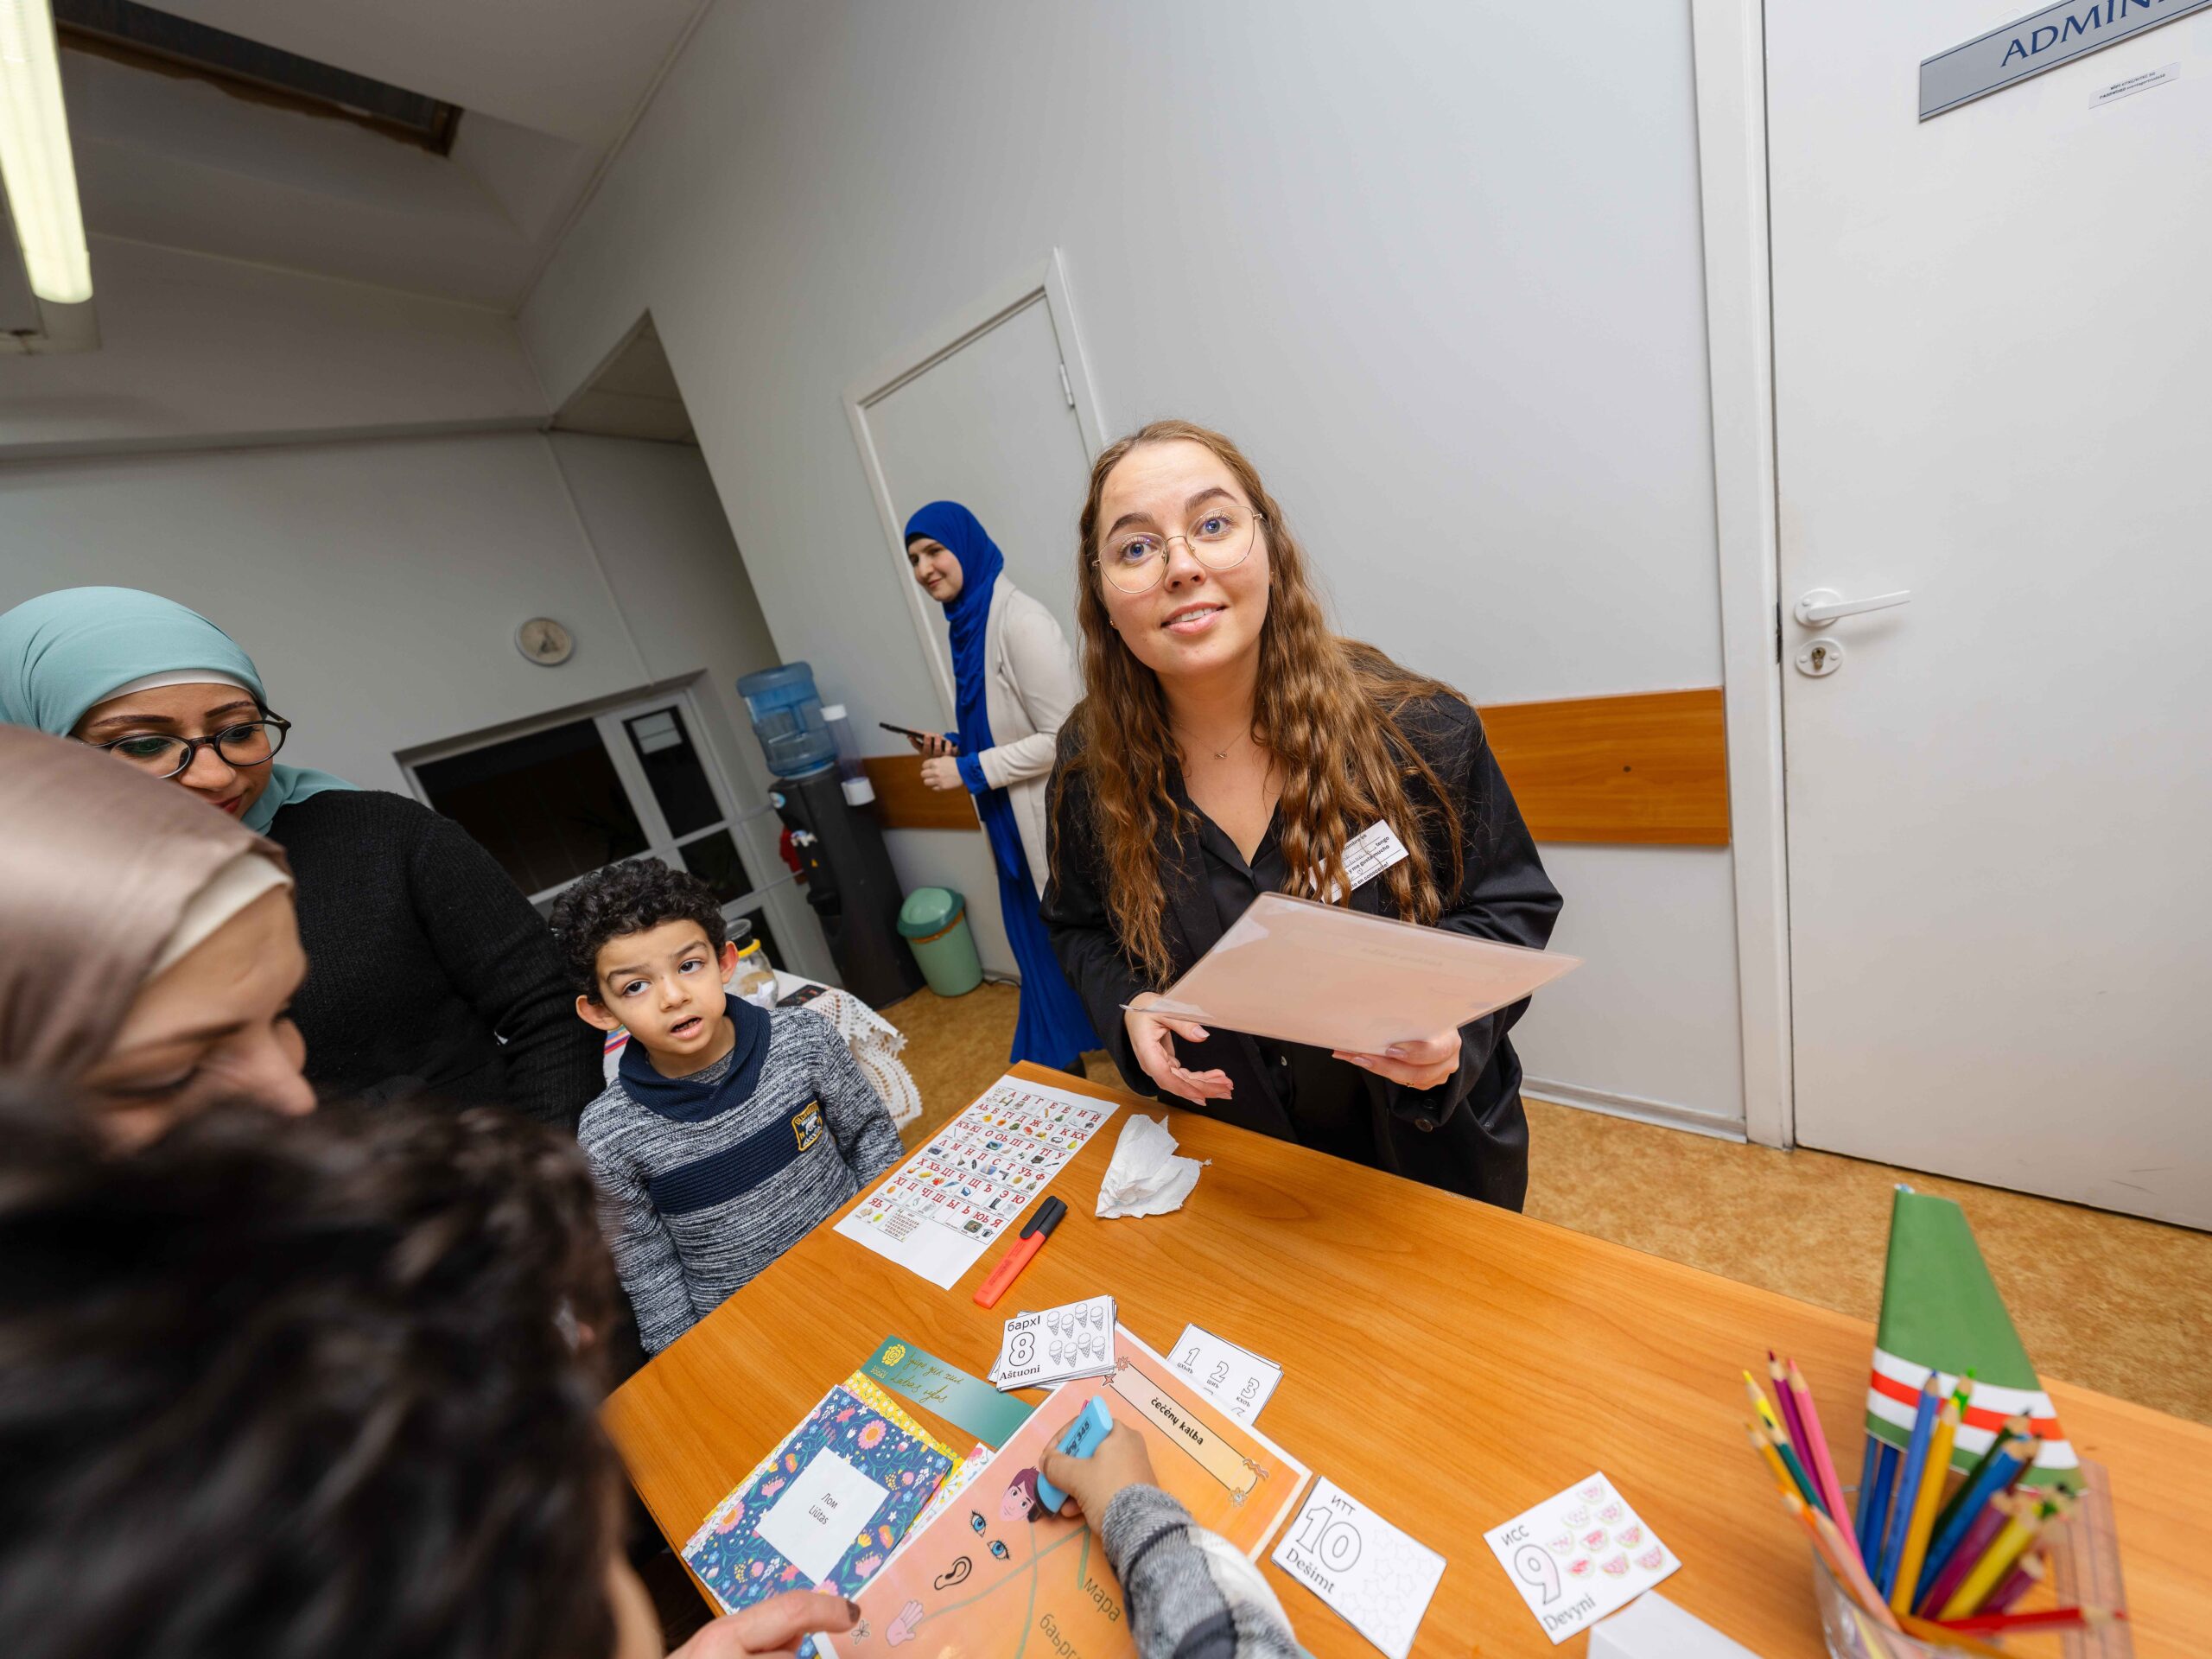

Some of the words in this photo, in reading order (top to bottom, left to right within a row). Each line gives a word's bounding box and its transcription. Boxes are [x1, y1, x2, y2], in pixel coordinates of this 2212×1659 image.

[2000, 0, 2164, 67] ADMIN
[1359, 855, 1373, 868] gusta
[1373, 844, 1389, 858] mucho
[1376, 836, 1389, 847] tengo
[1029, 1119, 1043, 1128] Ж
[1059, 1128, 1071, 1136] К
[963, 1147, 975, 1156] Н
[1006, 1162, 1016, 1171] Т
[1035, 1173, 1046, 1181] Ф
[958, 1173, 967, 1182] Ч
[968, 1178, 982, 1189] Щ
[999, 1190, 1009, 1198] Э
[1011, 1194, 1026, 1205] Ю
[931, 1193, 947, 1204] Ш
[946, 1198, 961, 1210] Ы
[961, 1205, 971, 1214] Ь
[990, 1218, 1004, 1229] Я
[1008, 1332, 1035, 1367] 8
[1184, 1347, 1200, 1367] 1
[999, 1365, 1040, 1381] Aštuoni
[1210, 1360, 1230, 1383] 2
[1241, 1377, 1260, 1400] 3
[1151, 1396, 1179, 1426] čečėnų
[1179, 1421, 1204, 1445] kalba
[809, 1504, 829, 1525] Liūtas
[821, 1492, 838, 1509] Лом
[1296, 1506, 1362, 1573] 10
[1286, 1548, 1335, 1594] Dešimt
[1514, 1543, 1561, 1605] 9
[1543, 1592, 1596, 1631] Devyni
[1039, 1613, 1082, 1659] баьрг
